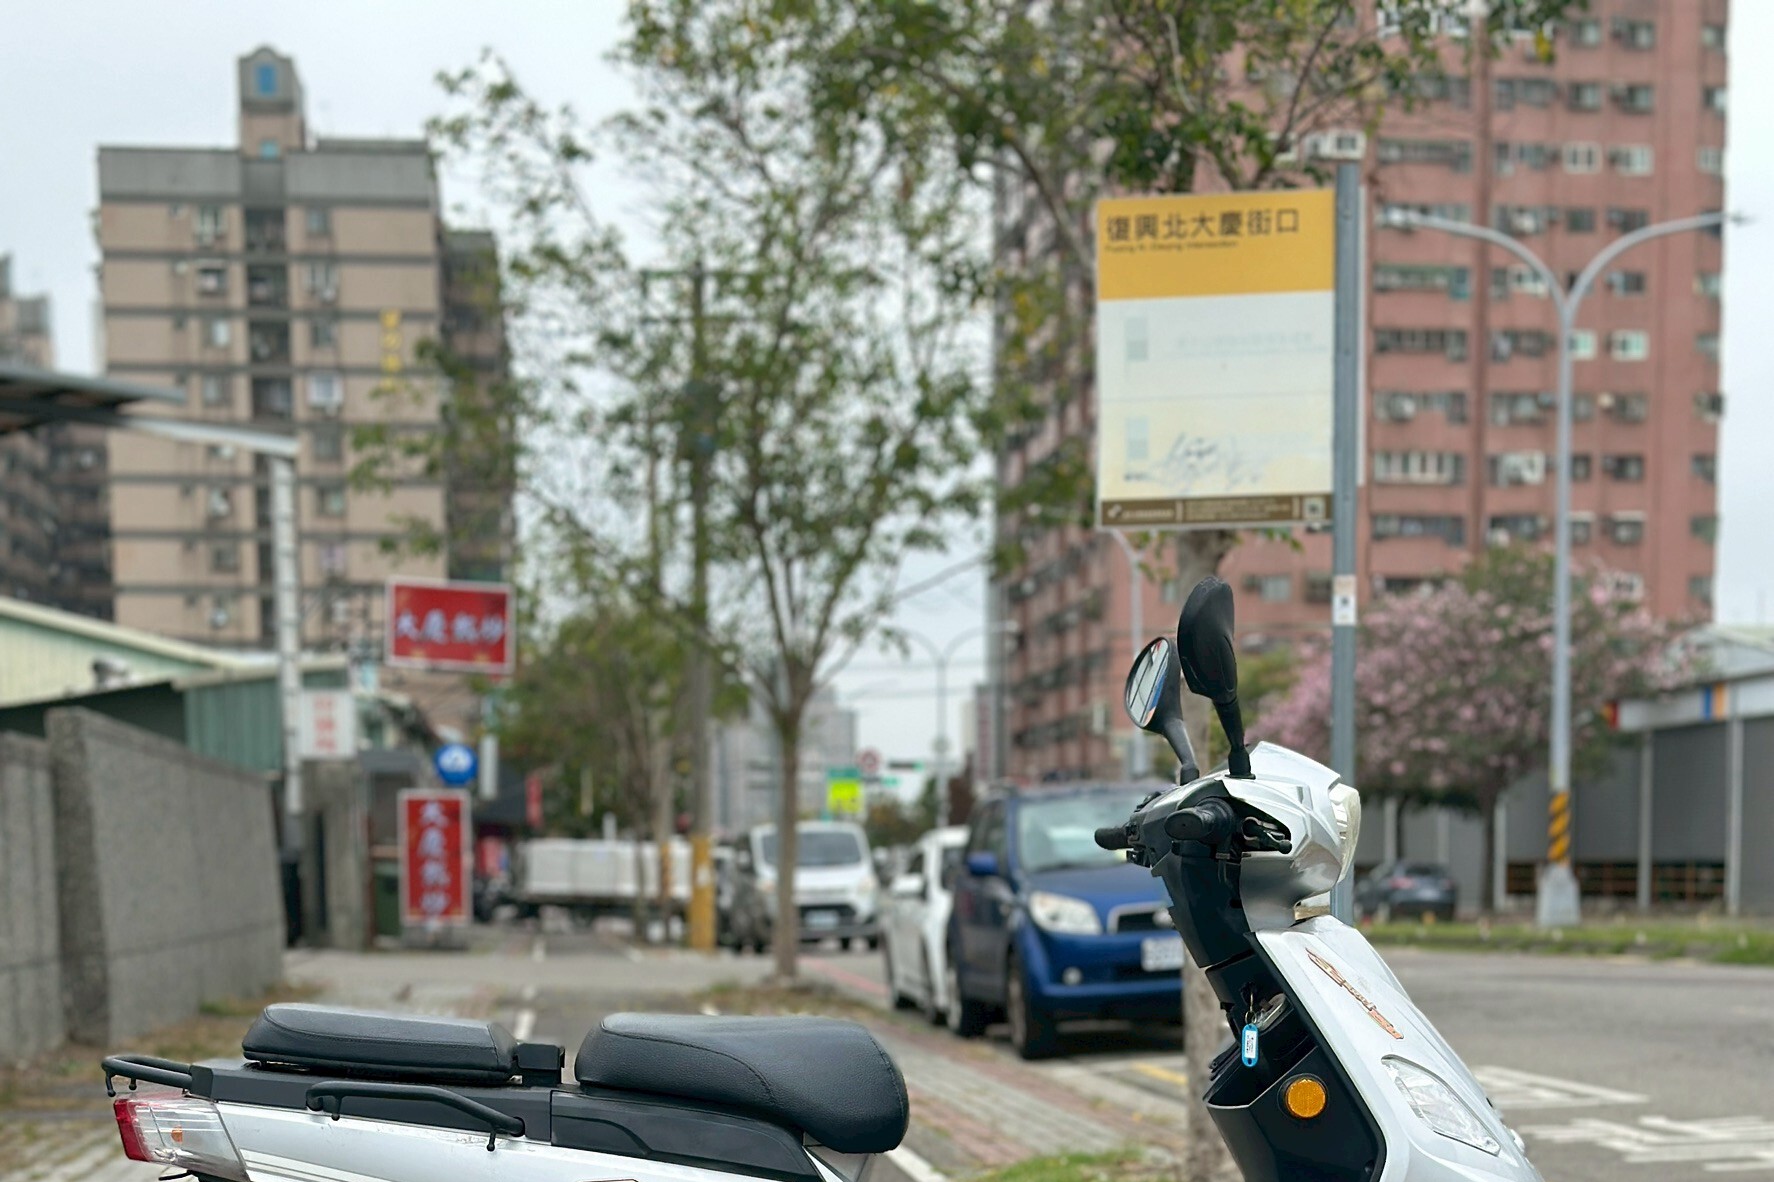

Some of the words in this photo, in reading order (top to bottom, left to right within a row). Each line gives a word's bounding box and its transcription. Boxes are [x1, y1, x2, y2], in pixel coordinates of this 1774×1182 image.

[1106, 207, 1300, 242] 復興北大慶街口
